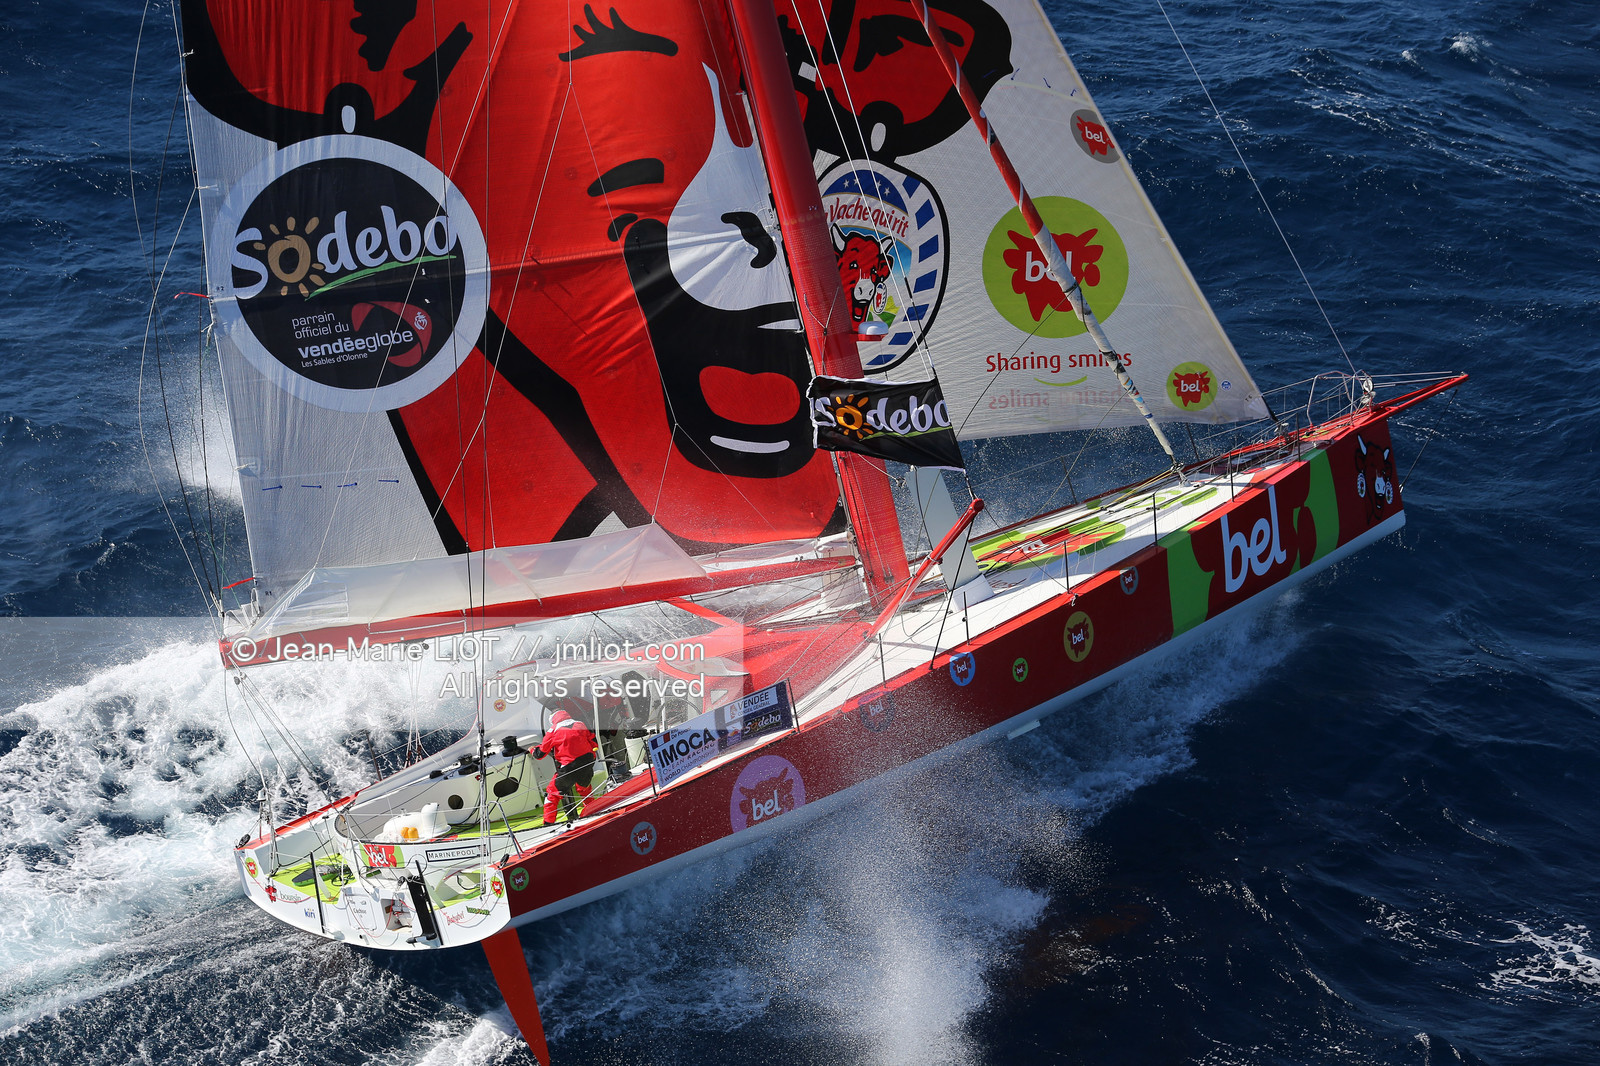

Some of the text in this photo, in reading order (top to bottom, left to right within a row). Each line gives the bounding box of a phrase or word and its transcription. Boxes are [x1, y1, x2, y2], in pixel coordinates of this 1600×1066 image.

[1085, 126, 1106, 144] bel
[230, 205, 458, 300] Sodebo
[292, 311, 336, 330] parrain
[294, 322, 349, 339] officiel du
[301, 352, 368, 368] Les Sables d'Olonne
[986, 351, 1061, 373] Sharing
[1180, 379, 1201, 393] bel
[811, 395, 951, 435] Sodebo
[1220, 484, 1287, 593] bel
[1072, 629, 1085, 645] bel
[957, 661, 968, 674] bel
[657, 726, 716, 769] IMOCA
[752, 789, 783, 821] bel
[638, 832, 648, 844] bel
[369, 846, 389, 866] bel
